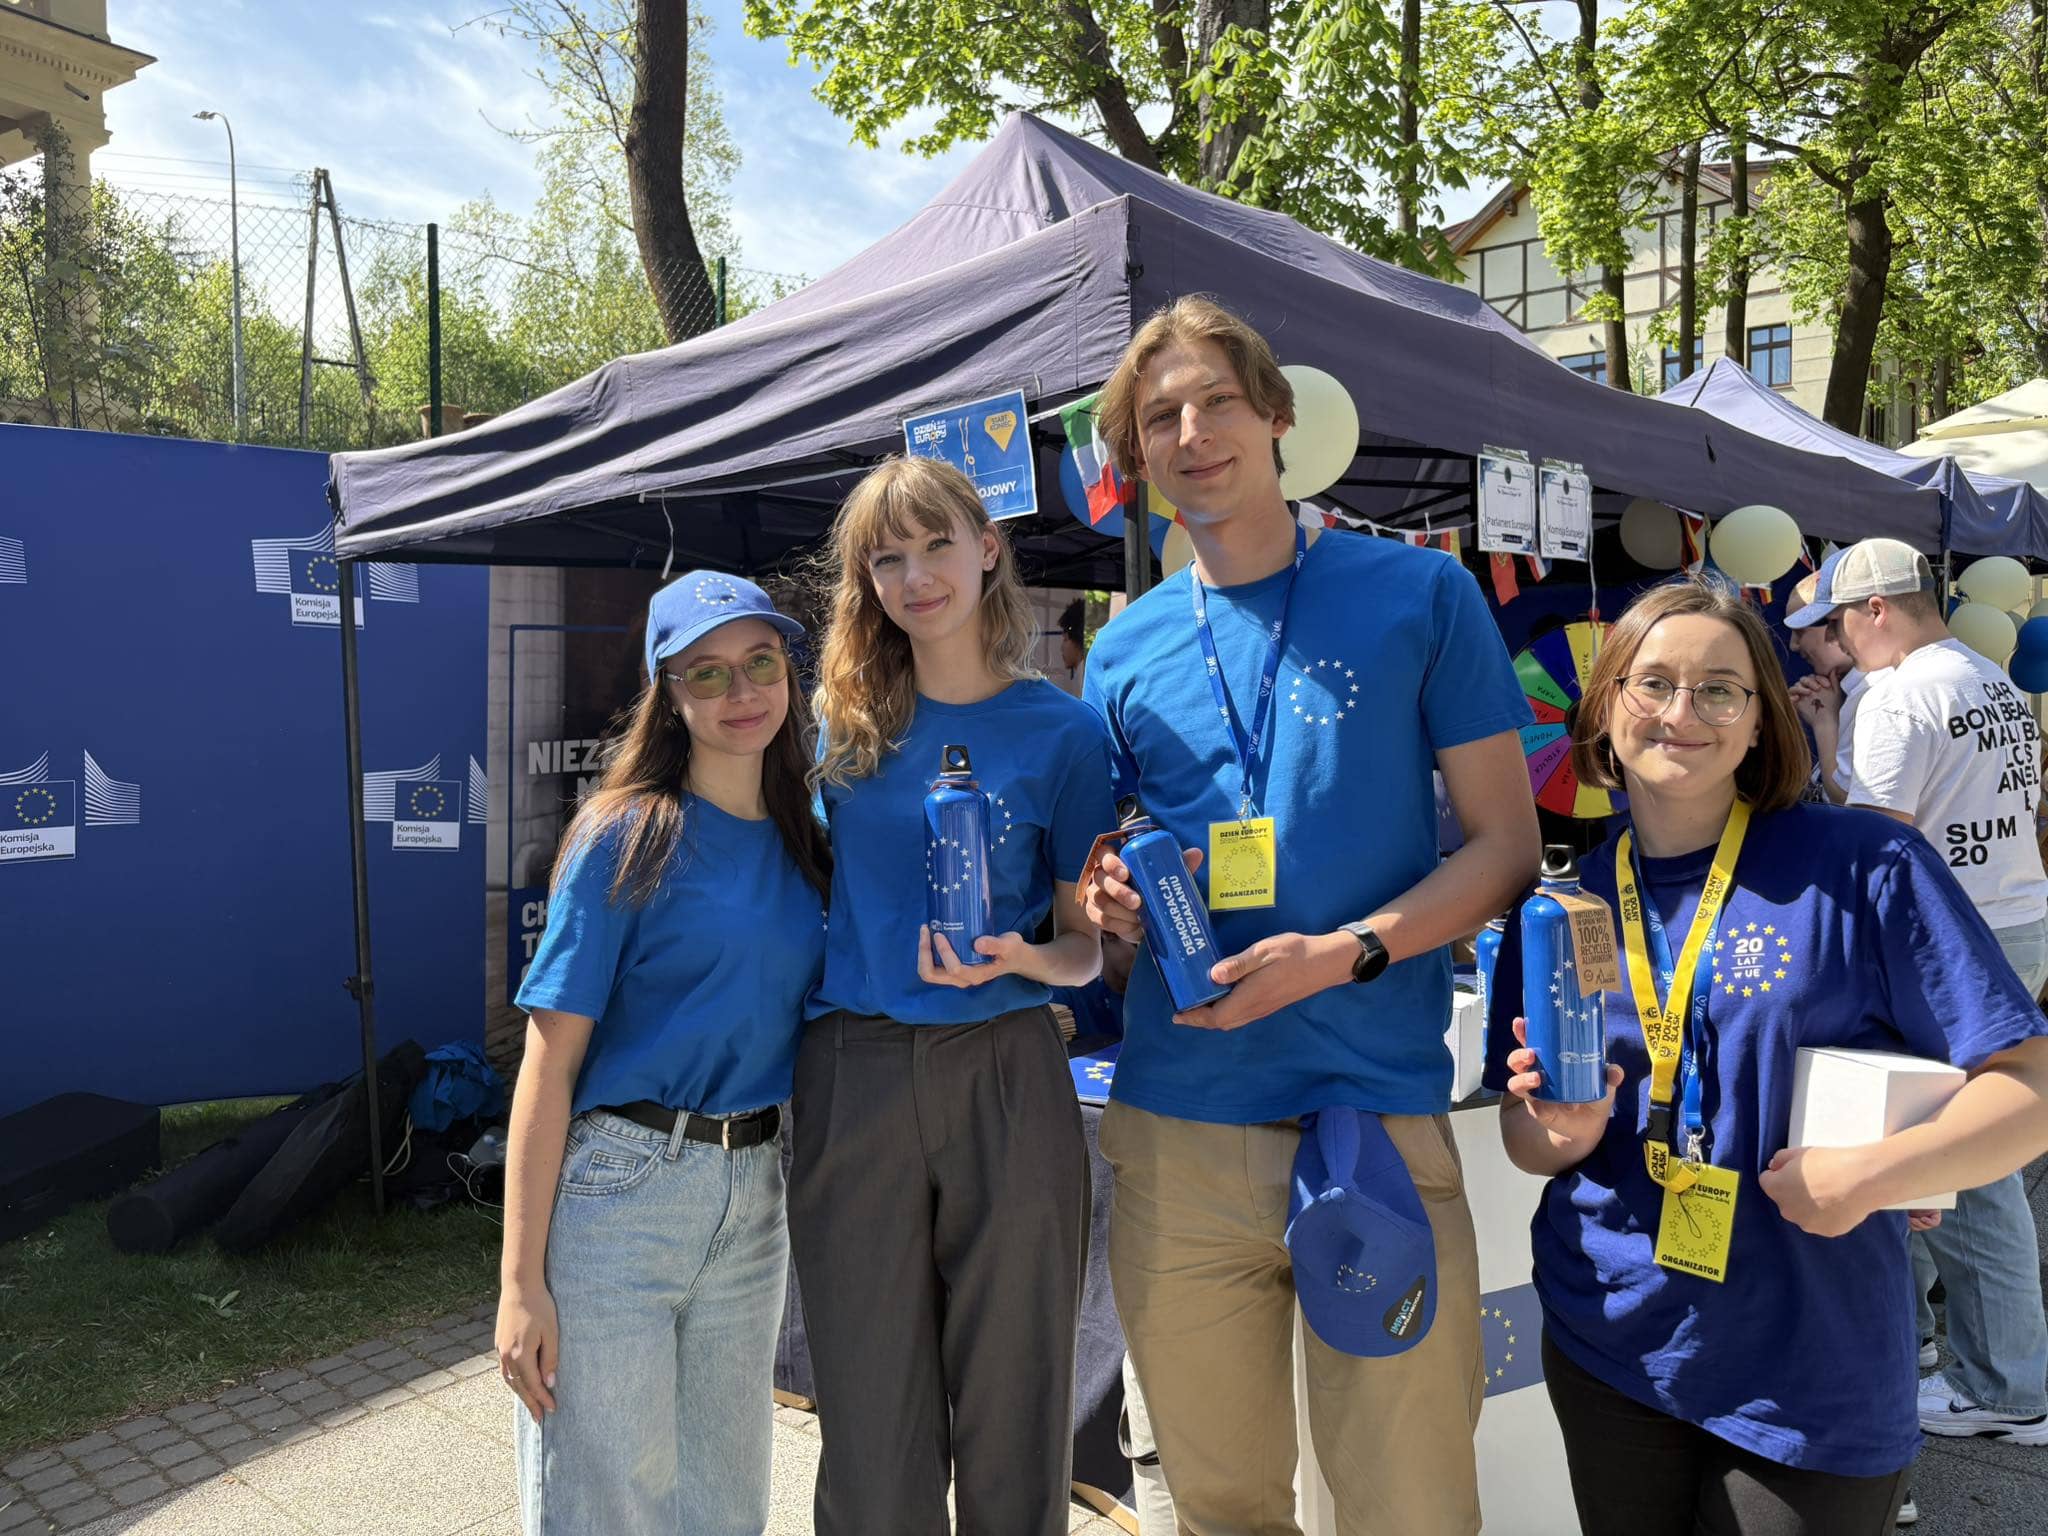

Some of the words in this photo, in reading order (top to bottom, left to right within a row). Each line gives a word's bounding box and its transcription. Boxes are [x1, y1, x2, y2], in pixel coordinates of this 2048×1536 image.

[915, 429, 947, 444] EUROPY
[978, 480, 1017, 498] OJOWY
[295, 597, 331, 609] Komisja
[296, 608, 341, 620] Europejsk
[1983, 682, 2015, 701] CAR
[1949, 704, 2001, 739] BON
[396, 824, 430, 834] Komisja
[1241, 828, 1267, 836] EUROPY
[1946, 816, 2017, 844] SUM
[0, 832, 40, 844] Komisja
[396, 834, 442, 844] Europejska
[0, 843, 55, 854] Europejska
[1949, 844, 1989, 867] 20
[1219, 888, 1268, 899] ORGANIZATOR
[1702, 874, 1719, 904] DOLNY
[1169, 875, 1201, 936] DZIAŁANIU
[1630, 896, 1640, 922] DOLNY
[1158, 876, 1197, 956] DEMOKRACJA
[1578, 925, 1610, 944] 100%
[1194, 938, 1207, 950] W
[1581, 943, 1612, 956] RECYCLED
[1735, 937, 1764, 954] 20
[1737, 956, 1758, 966] LAT
[1745, 968, 1761, 978] UE
[1663, 1010, 1673, 1042] DOLNY
[1652, 1146, 1660, 1179] DOLNY
[1697, 1184, 1731, 1198] EUROPY
[1661, 1254, 1720, 1277] ORGANIZATOR
[1390, 1298, 1412, 1334] IMPACT
